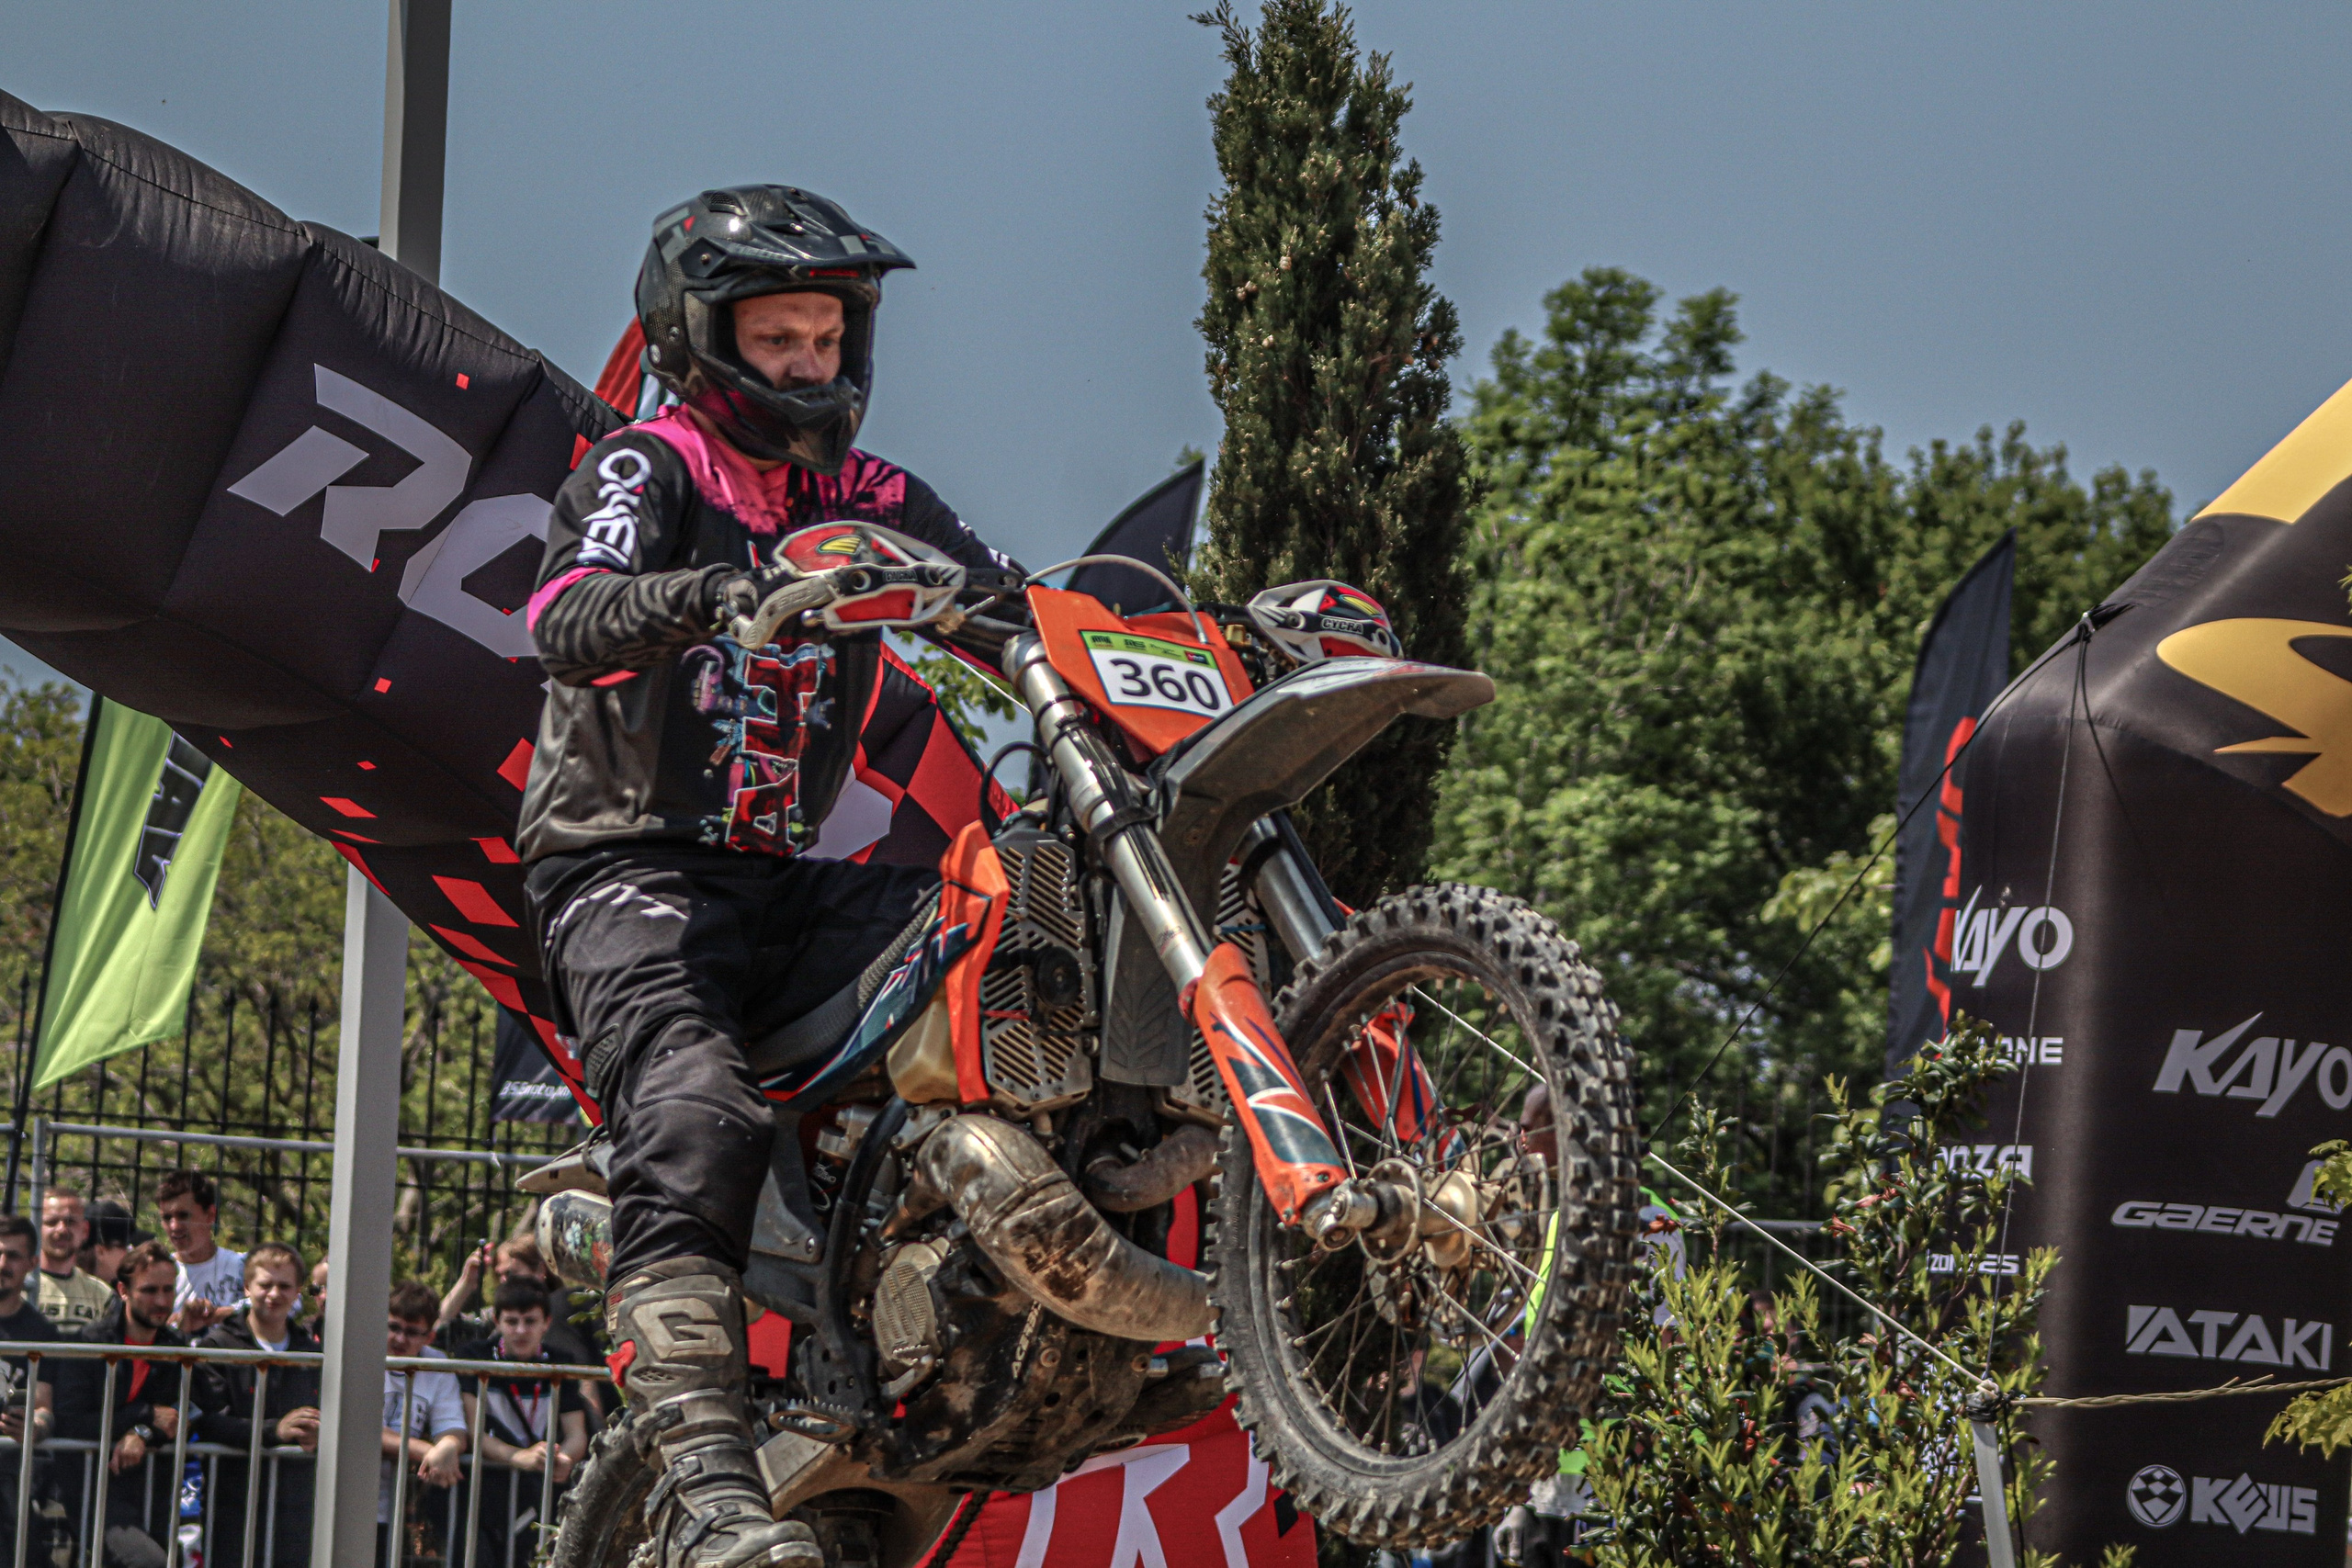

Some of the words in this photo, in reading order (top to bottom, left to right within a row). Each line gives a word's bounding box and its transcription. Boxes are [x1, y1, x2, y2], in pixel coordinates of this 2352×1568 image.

[1321, 617, 1364, 635] CYCRA
[1109, 658, 1220, 710] 360
[2153, 1011, 2352, 1118] KAYO
[2126, 1304, 2332, 1371] ATAKI
